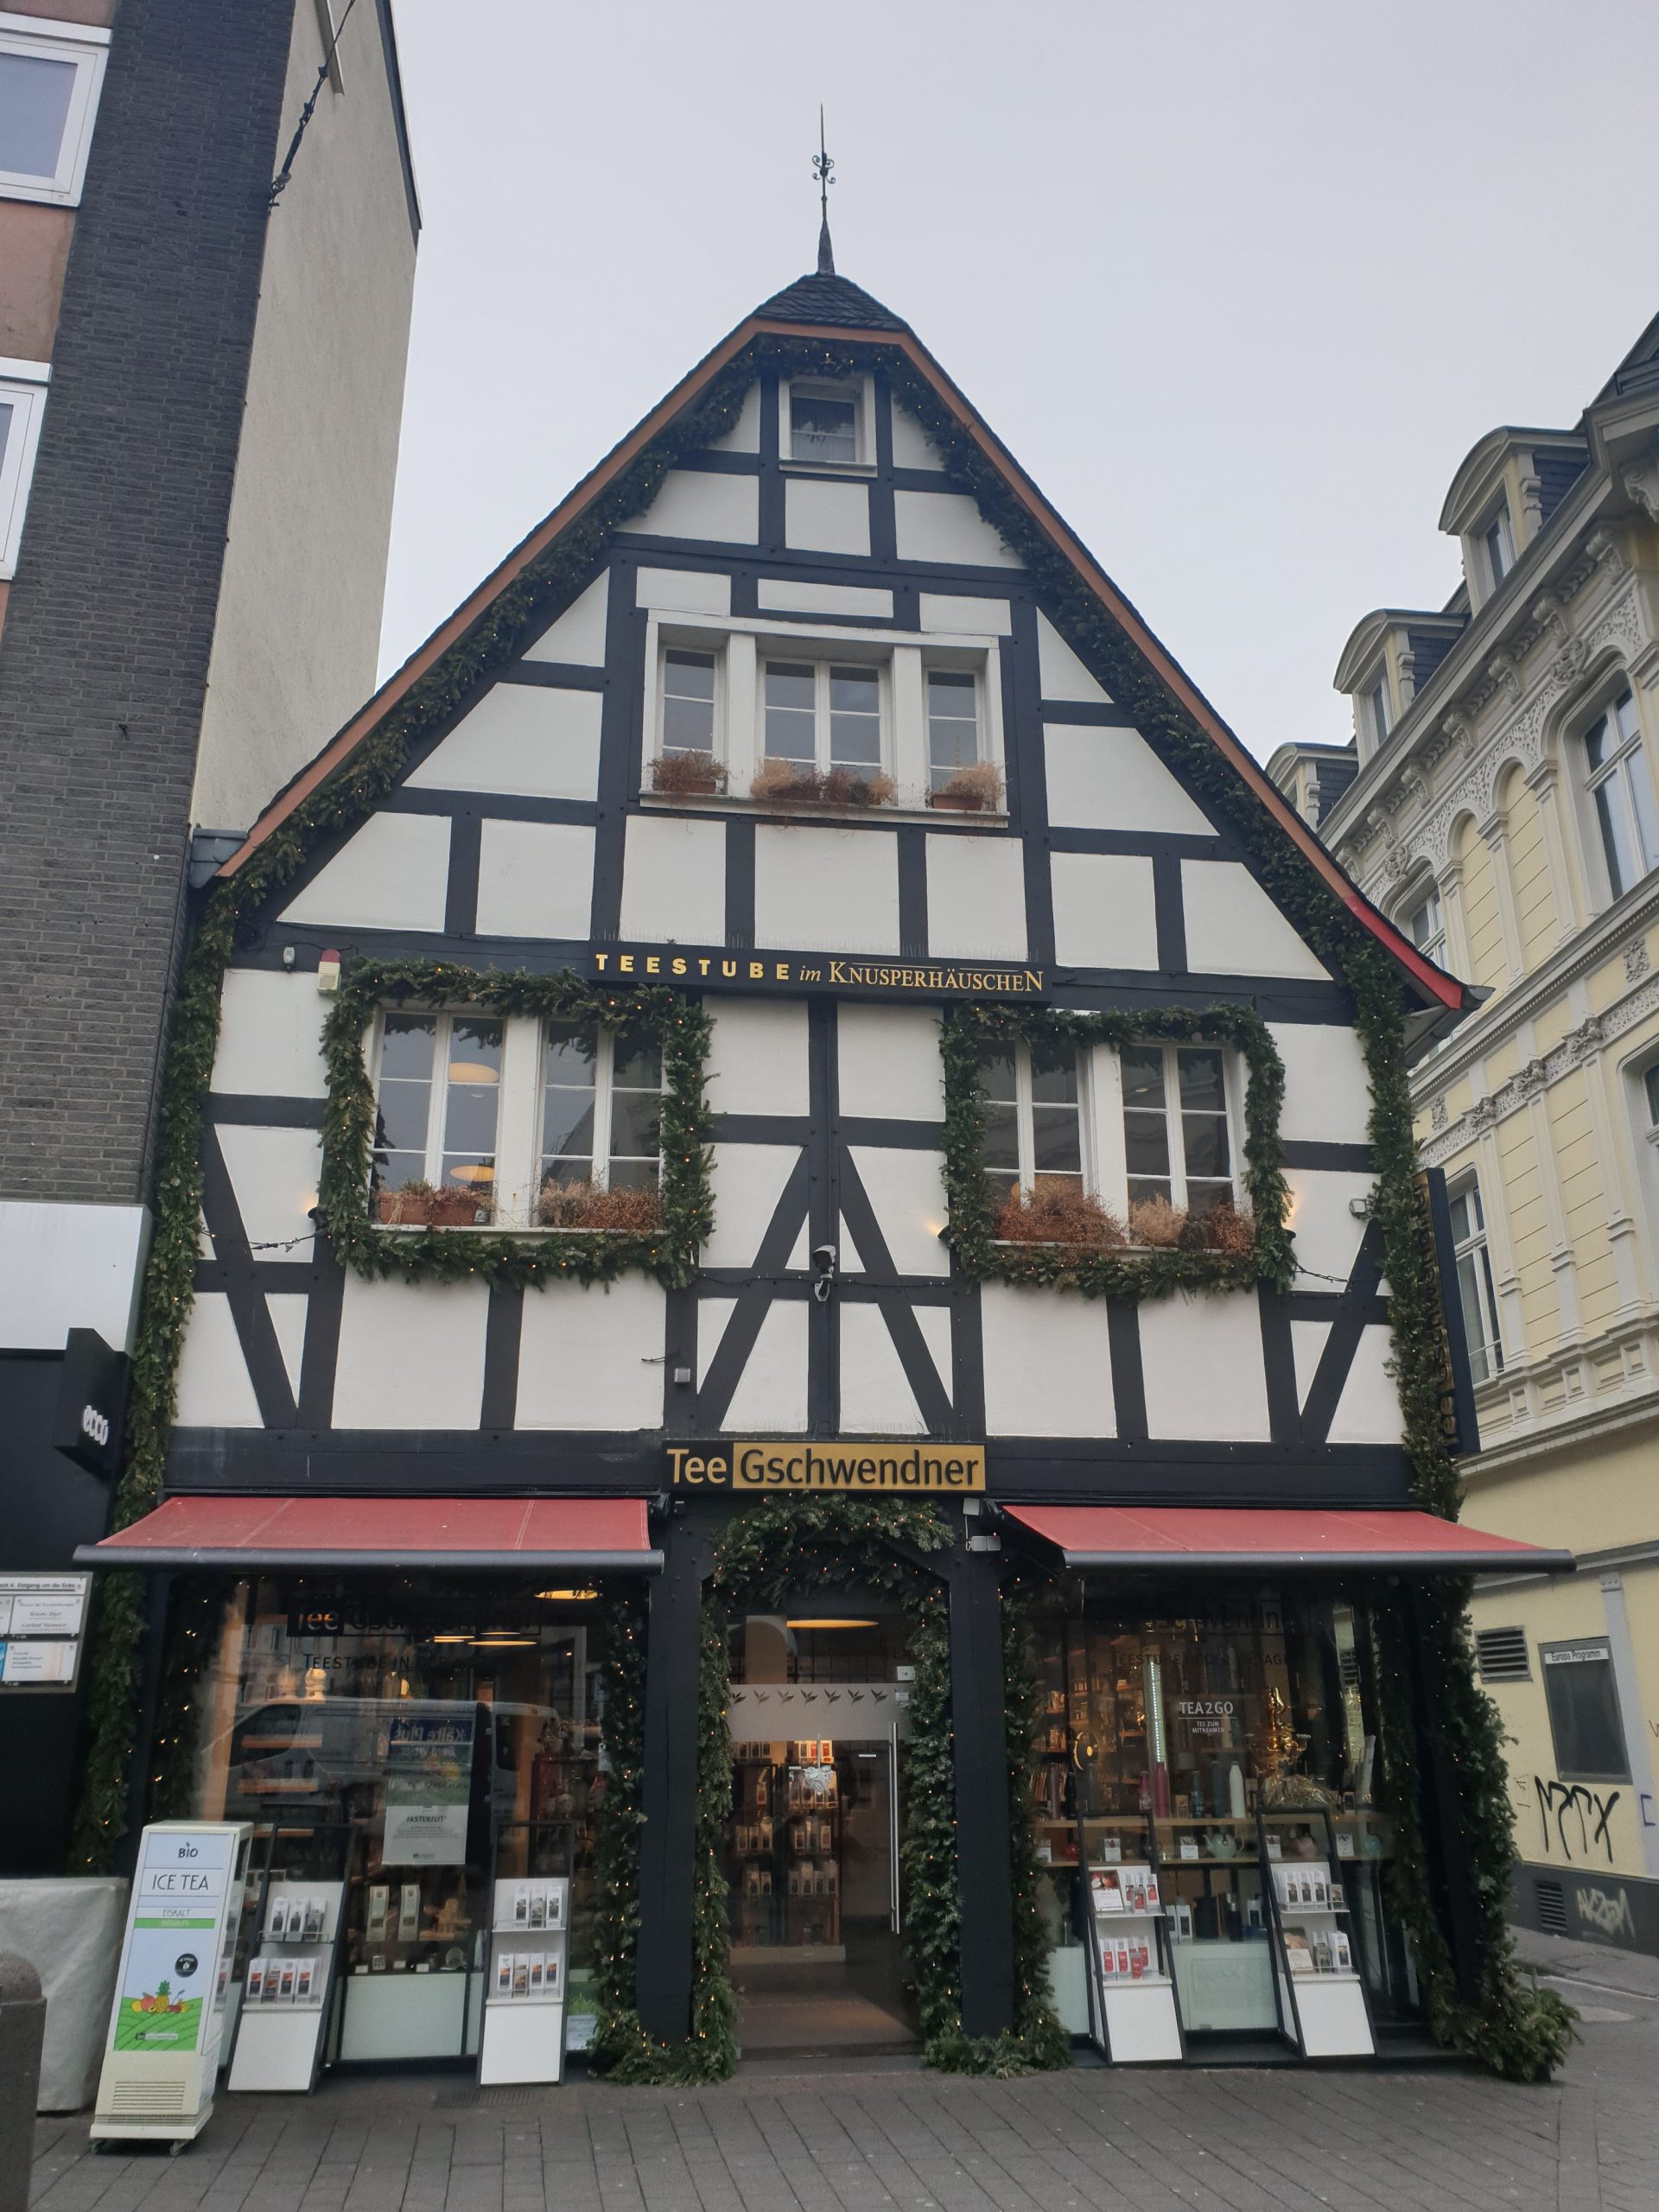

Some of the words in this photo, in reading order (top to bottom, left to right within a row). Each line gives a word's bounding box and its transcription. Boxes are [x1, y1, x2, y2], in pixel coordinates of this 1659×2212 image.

[595, 953, 789, 980] TEESTUBE
[799, 964, 821, 982] im
[666, 1448, 728, 1484] Tee
[740, 1448, 980, 1486] Gschwendner
[1552, 1652, 1571, 1662] Europa
[1572, 1650, 1601, 1662] Programm
[152, 1874, 177, 1891] ICE
[181, 1874, 209, 1891] TEA
[162, 1908, 190, 1916] EISKALT
